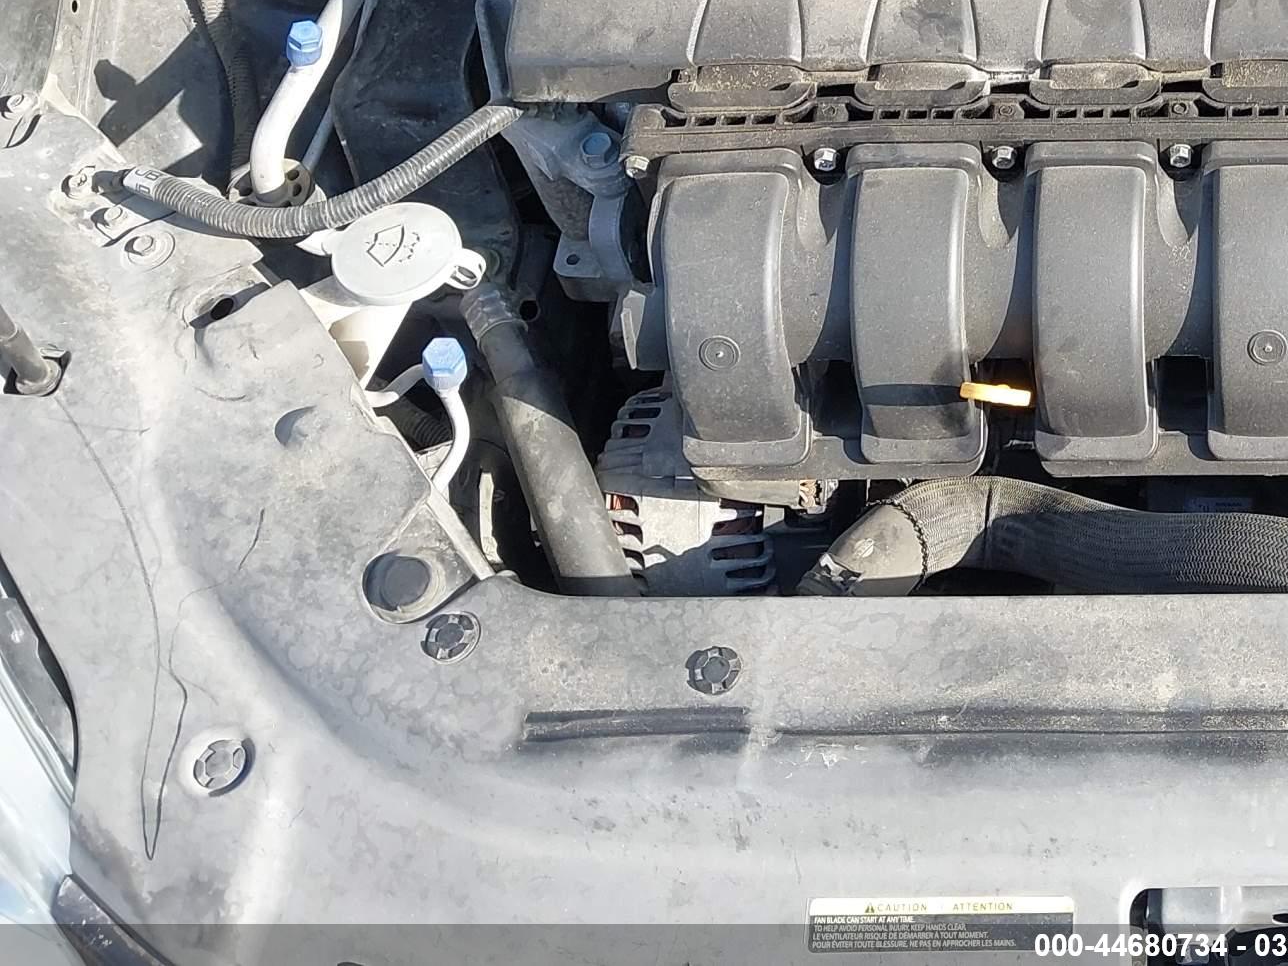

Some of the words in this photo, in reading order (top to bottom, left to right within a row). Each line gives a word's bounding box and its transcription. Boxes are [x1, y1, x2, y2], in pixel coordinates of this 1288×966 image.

[877, 903, 927, 912] CAUTION
[952, 902, 1013, 912] ATTENTION
[814, 916, 826, 924] FAN
[826, 916, 845, 924] BLADE
[846, 916, 860, 924] CAN
[860, 916, 878, 924] START
